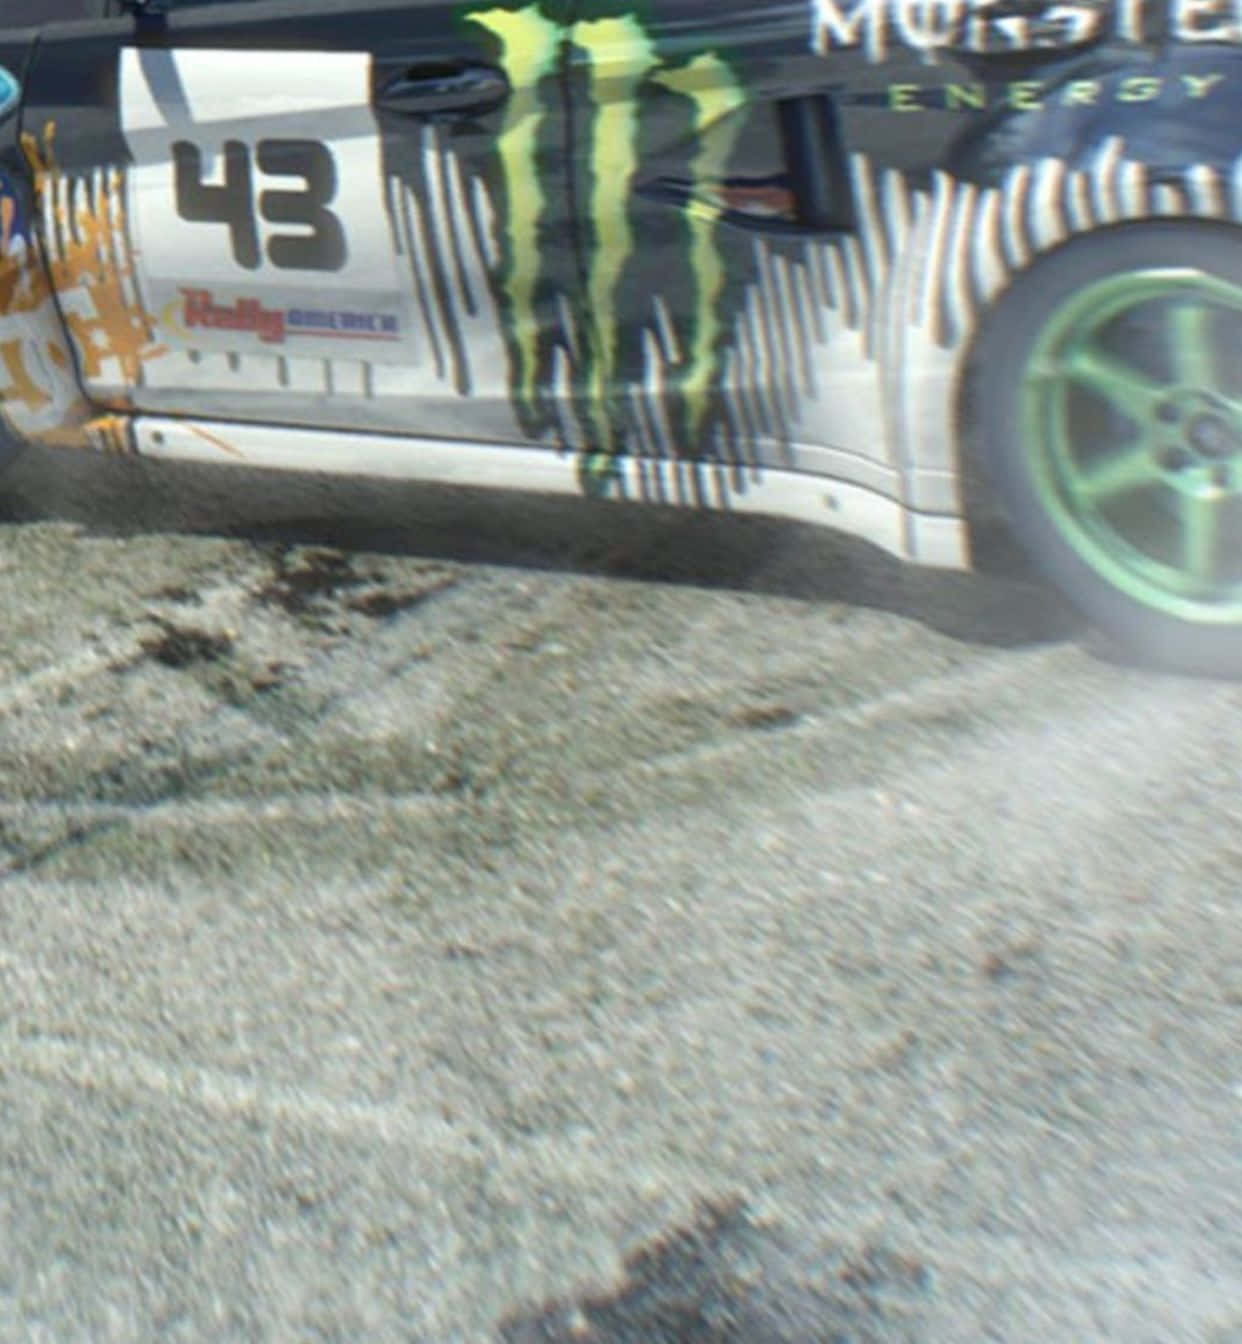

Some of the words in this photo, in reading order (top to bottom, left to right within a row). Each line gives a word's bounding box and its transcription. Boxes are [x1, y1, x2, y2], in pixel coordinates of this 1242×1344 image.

[888, 73, 1224, 112] ENERGY
[171, 138, 347, 273] 43
[180, 287, 285, 344] Rally
